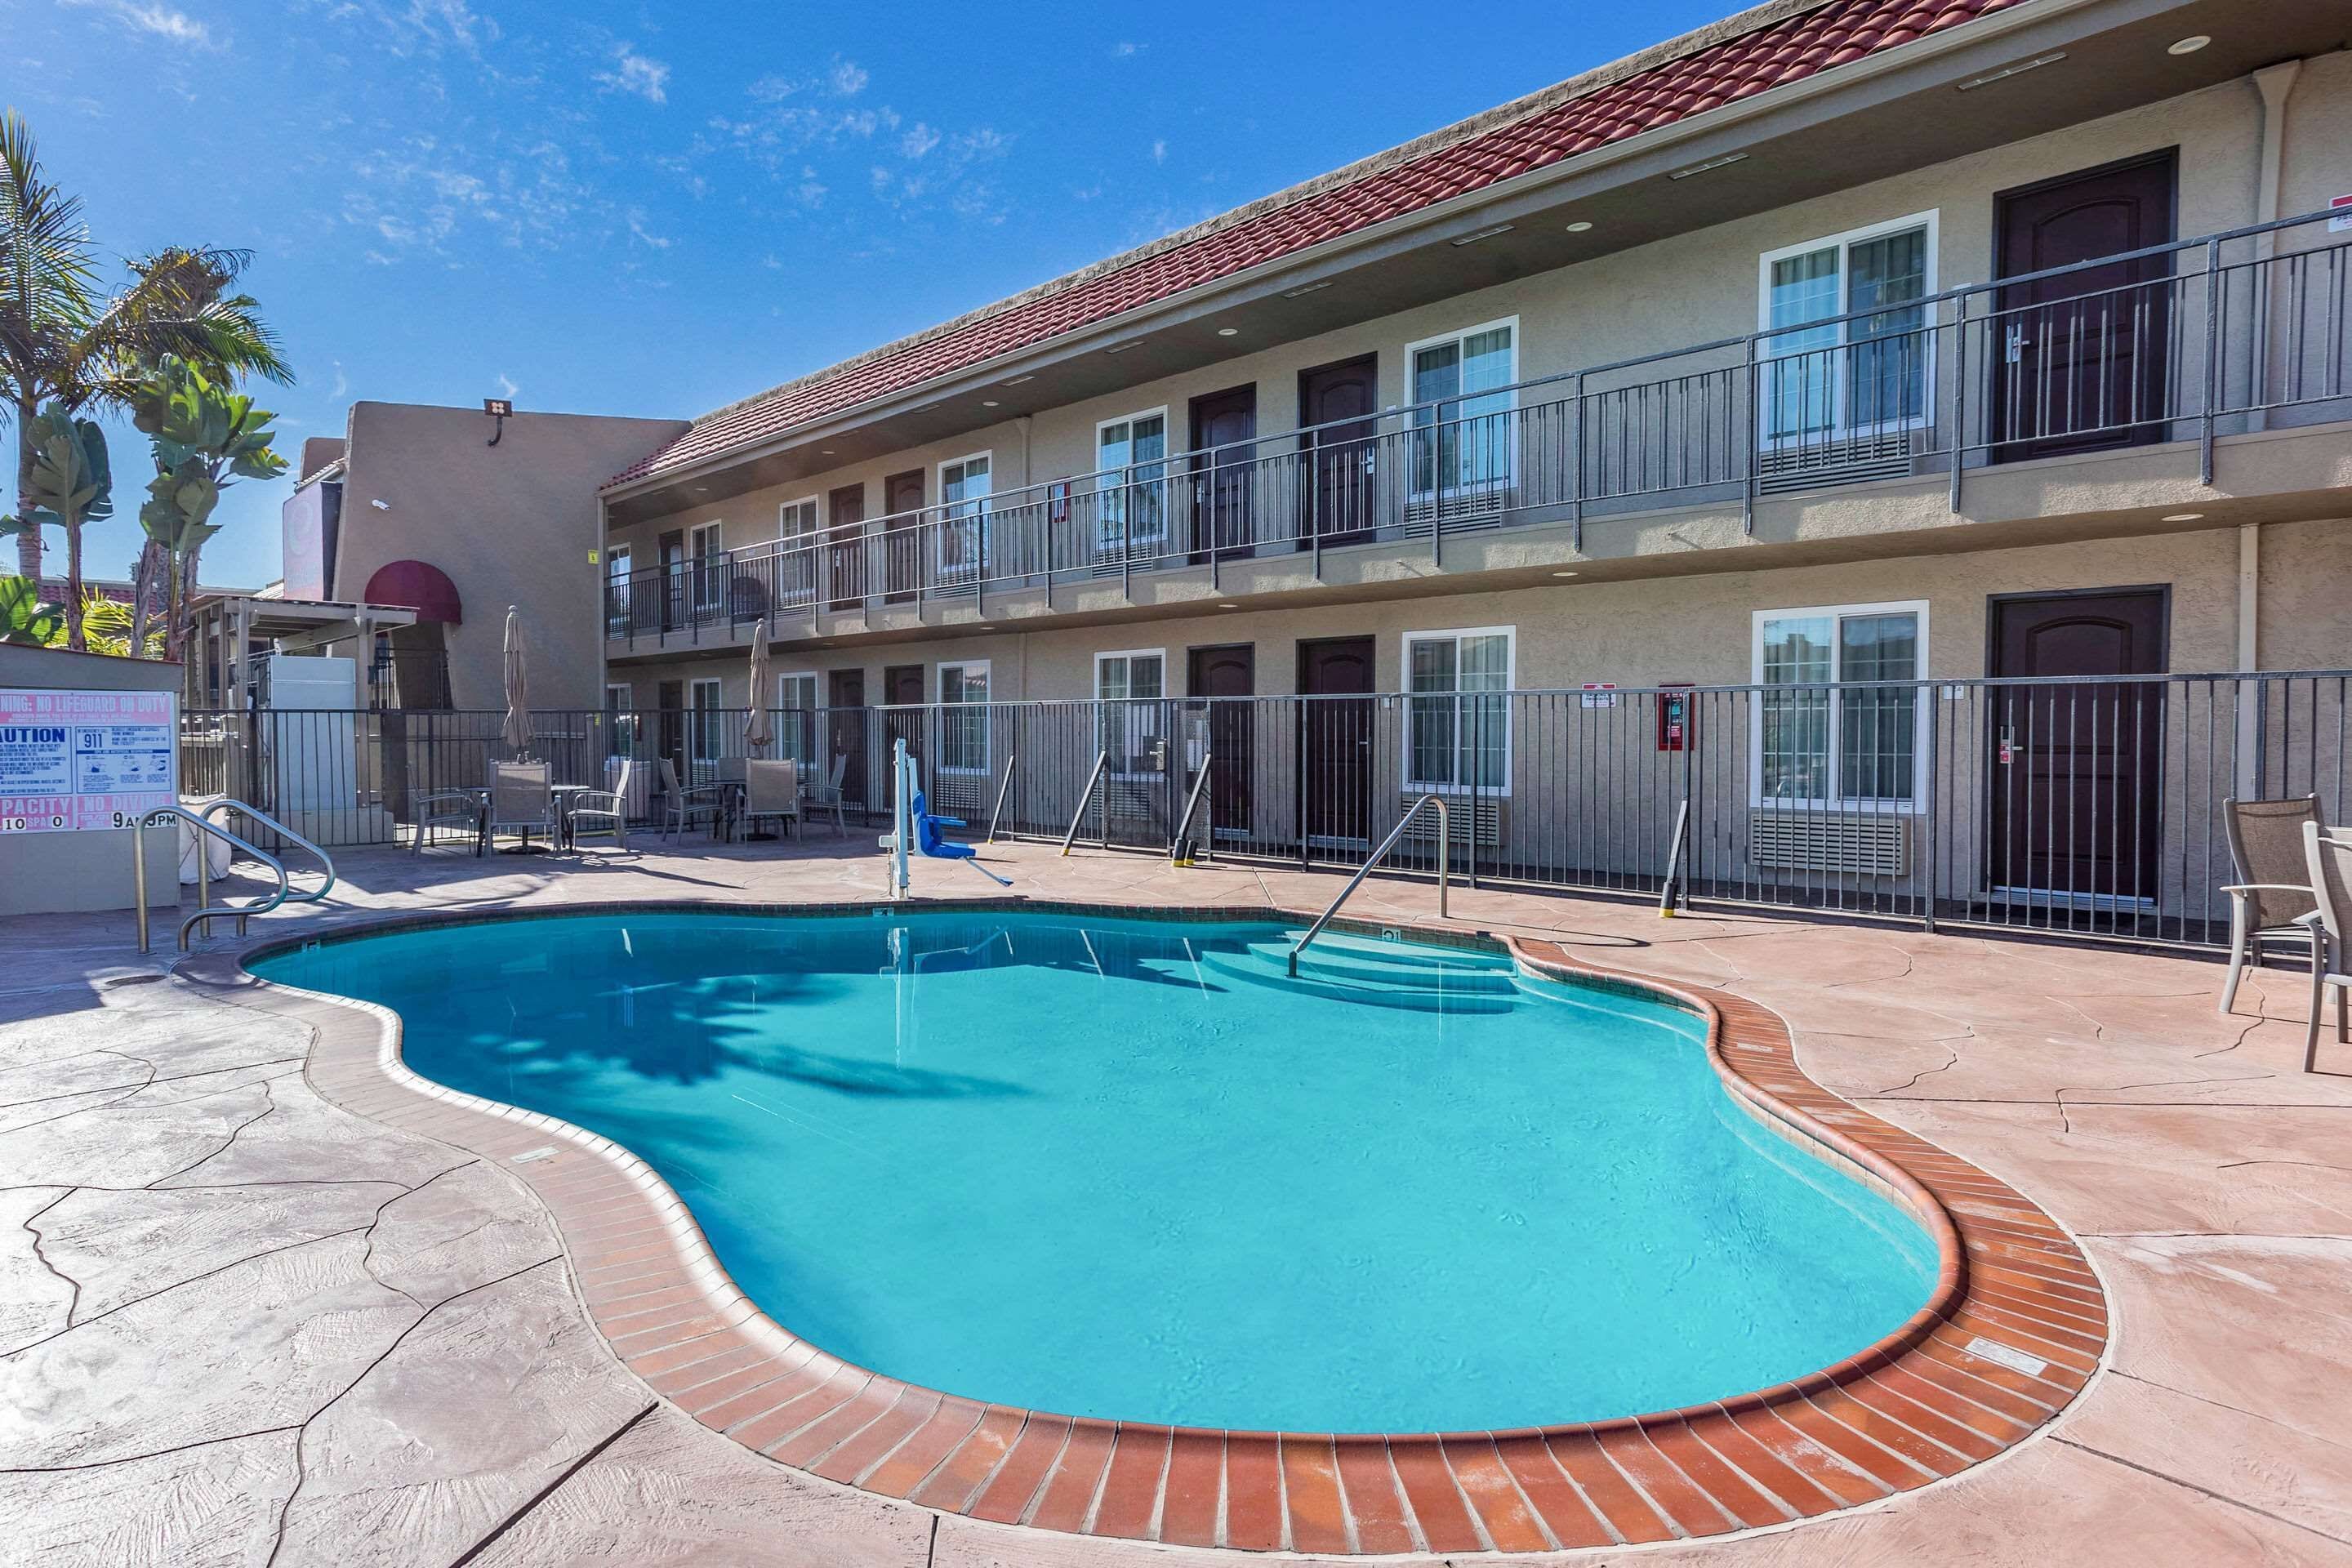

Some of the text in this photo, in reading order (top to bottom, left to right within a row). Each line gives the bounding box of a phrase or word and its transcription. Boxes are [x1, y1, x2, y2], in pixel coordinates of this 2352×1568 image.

[36, 695, 51, 712] NO
[56, 695, 115, 712] LIFEGUARD
[120, 696, 134, 713] ON
[138, 696, 166, 713] DUTY
[84, 733, 103, 748] 911
[84, 796, 105, 812] NO
[6, 817, 25, 830] 10
[27, 816, 47, 827] SPA
